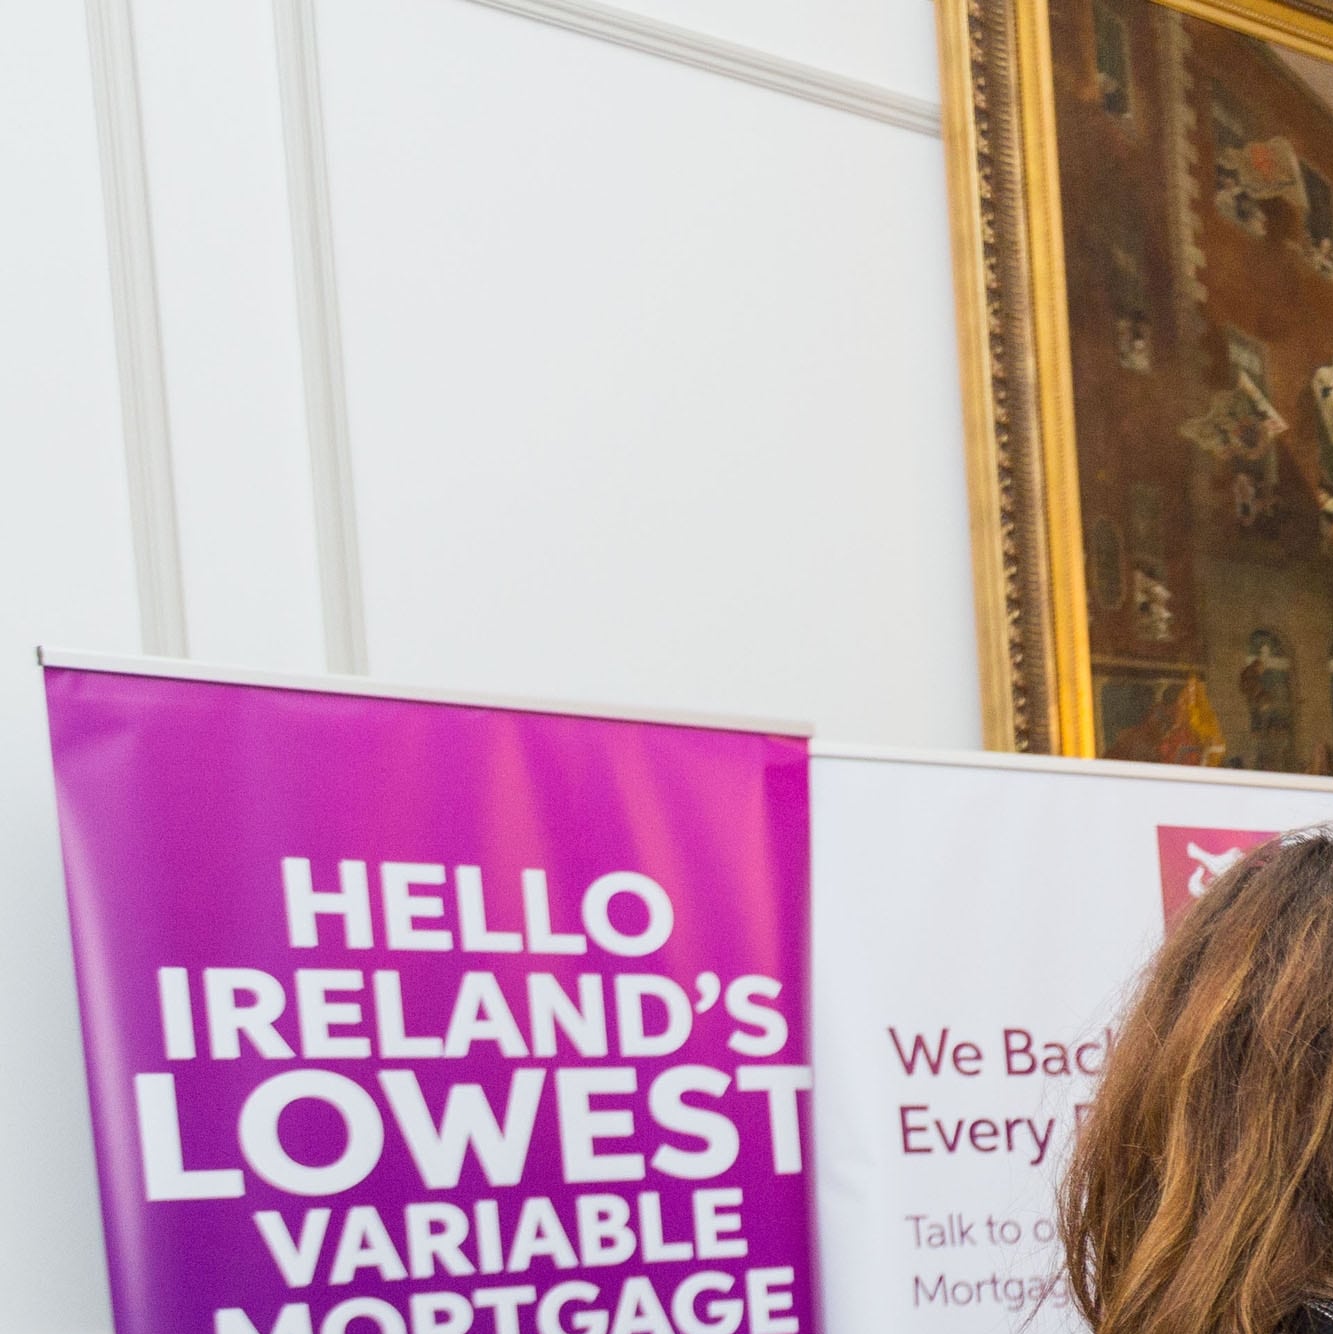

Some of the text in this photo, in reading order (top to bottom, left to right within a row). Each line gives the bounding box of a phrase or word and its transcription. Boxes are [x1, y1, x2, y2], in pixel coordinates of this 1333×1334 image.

[281, 856, 675, 957] HELLO
[157, 965, 790, 1061] IRELAND'S
[887, 1025, 983, 1076] We
[134, 1063, 814, 1202] LOWEST
[900, 1104, 1056, 1166] Every
[253, 1187, 749, 1289] VARIABLE
[905, 1213, 977, 1251] Talk
[985, 1217, 1022, 1244] to
